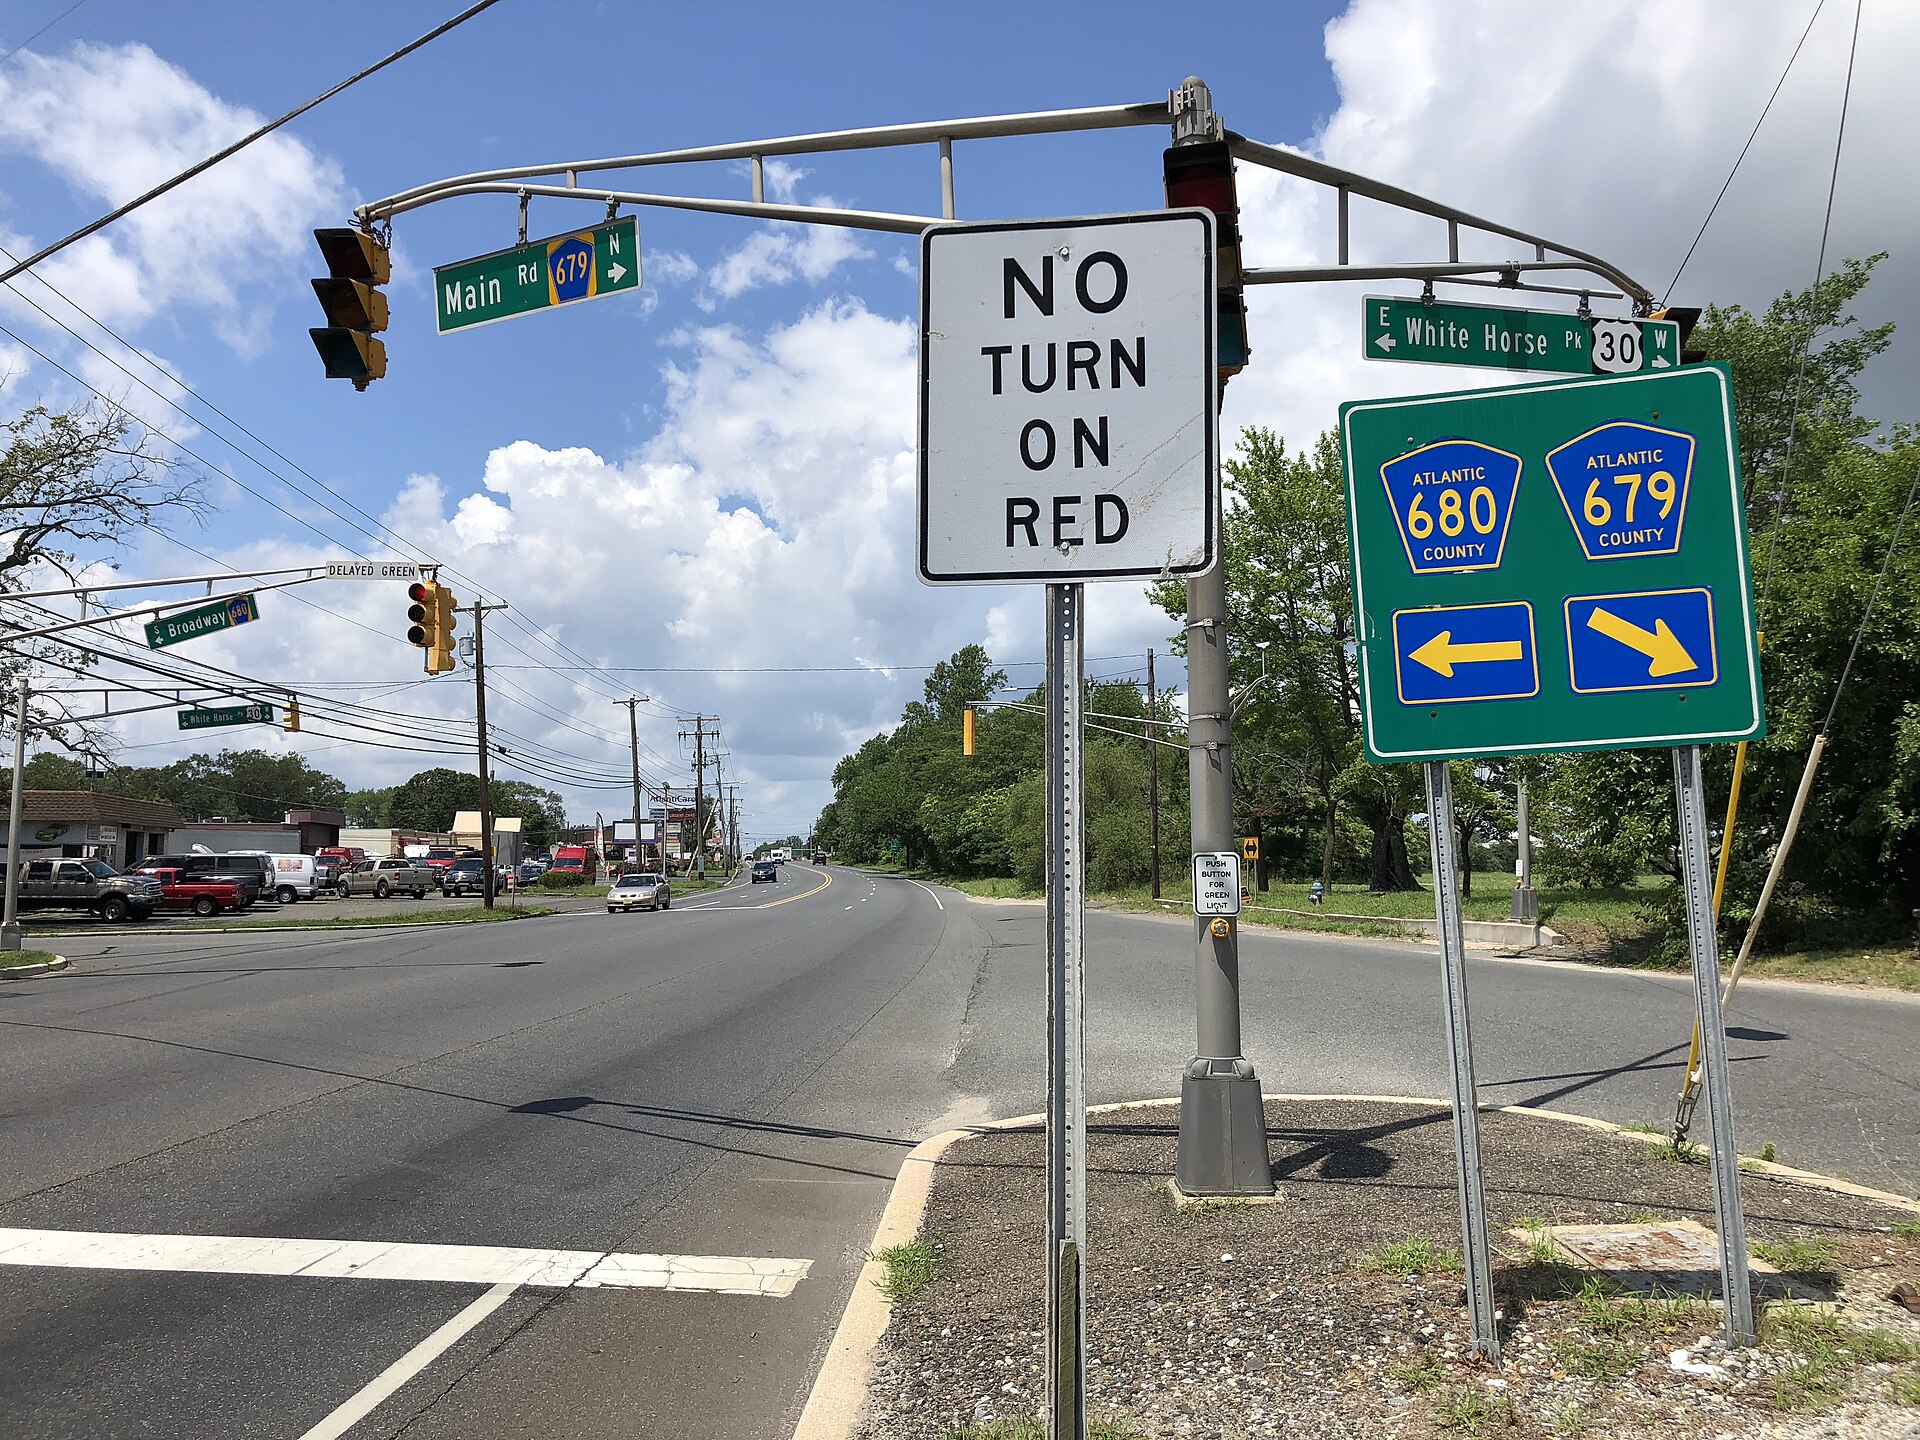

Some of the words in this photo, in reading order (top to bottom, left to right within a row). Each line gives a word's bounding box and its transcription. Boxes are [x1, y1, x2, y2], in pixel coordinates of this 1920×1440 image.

[445, 275, 502, 315] Main
[518, 262, 538, 286] Rd
[556, 251, 588, 285] 679
[609, 232, 620, 256] N
[1003, 251, 1128, 319] NO
[1379, 306, 1390, 326] E
[1405, 317, 1469, 349] White
[1484, 324, 1548, 355] Horse
[1565, 330, 1582, 349] Pk
[1600, 331, 1635, 364] 30
[1654, 329, 1668, 349] W
[981, 336, 1146, 395] TURN
[1019, 415, 1109, 471] ON
[1587, 449, 1664, 470] ATLANTIC
[1412, 466, 1486, 486] ATLANTIC
[1583, 470, 1676, 527] 679
[1006, 493, 1130, 548] RED
[1407, 486, 1497, 540] 680
[1599, 527, 1665, 548] COUNTY
[329, 565, 374, 577] DELAYED
[381, 566, 415, 577] GREEN
[1423, 543, 1486, 562] COUNTY
[154, 625, 160, 635] S
[167, 610, 226, 638] Broadway
[231, 601, 248, 618] 680
[190, 713, 210, 724] White
[213, 711, 234, 722] Horse
[248, 709, 260, 719] 30
